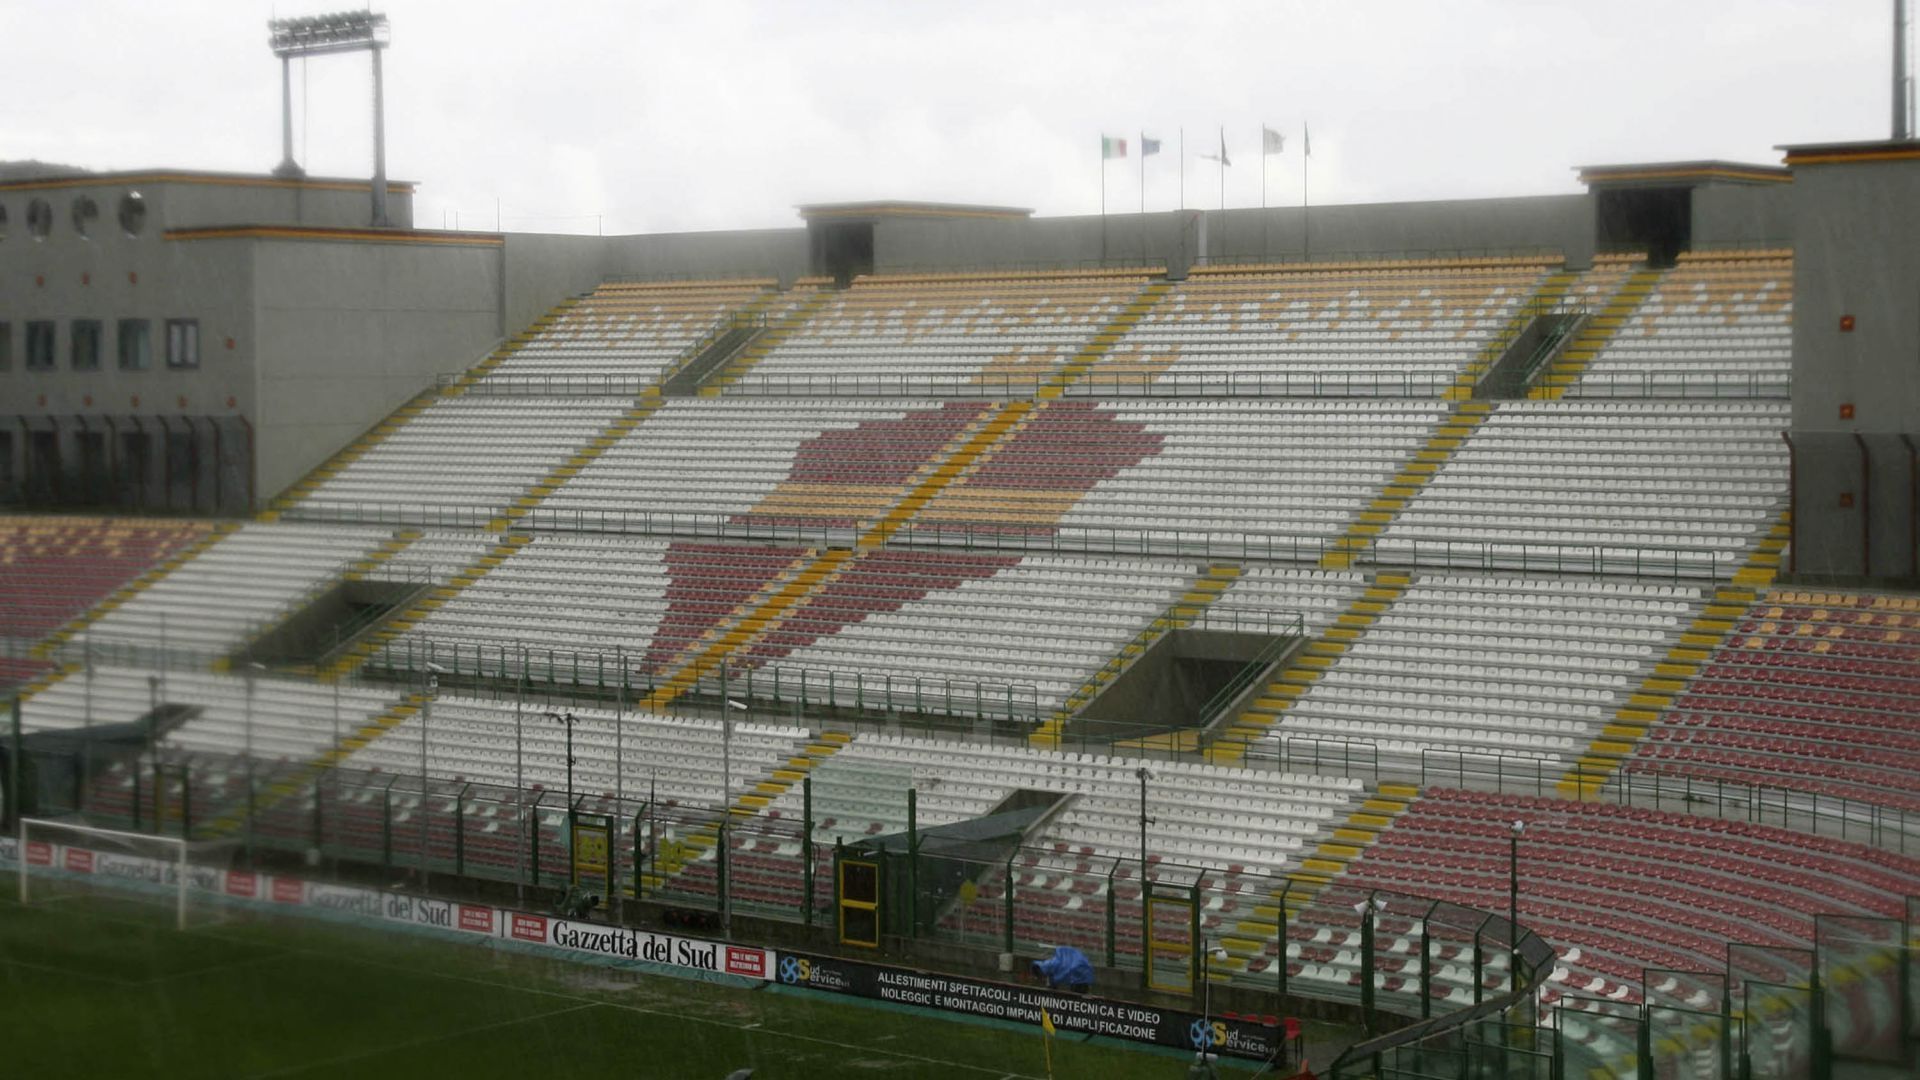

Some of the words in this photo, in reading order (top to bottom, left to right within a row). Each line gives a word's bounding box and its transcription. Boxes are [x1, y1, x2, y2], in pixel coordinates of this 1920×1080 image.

[308, 883, 384, 918] Gazzetta
[388, 893, 413, 920] del
[418, 899, 452, 927] Sud
[553, 920, 638, 959] Gazzetta
[643, 934, 673, 964] del
[677, 939, 718, 970] Sud
[877, 971, 948, 992] ALLESTIMENTI
[949, 982, 1011, 1002] SPETTACOLI
[1117, 1007, 1125, 1019] E
[1127, 1009, 1161, 1025] VIDEO
[934, 994, 942, 1006] E
[943, 996, 1004, 1016] MONTAGGIO
[1052, 1013, 1064, 1025] DI
[1065, 1016, 1157, 1041] AMPLIFICAZIONE
